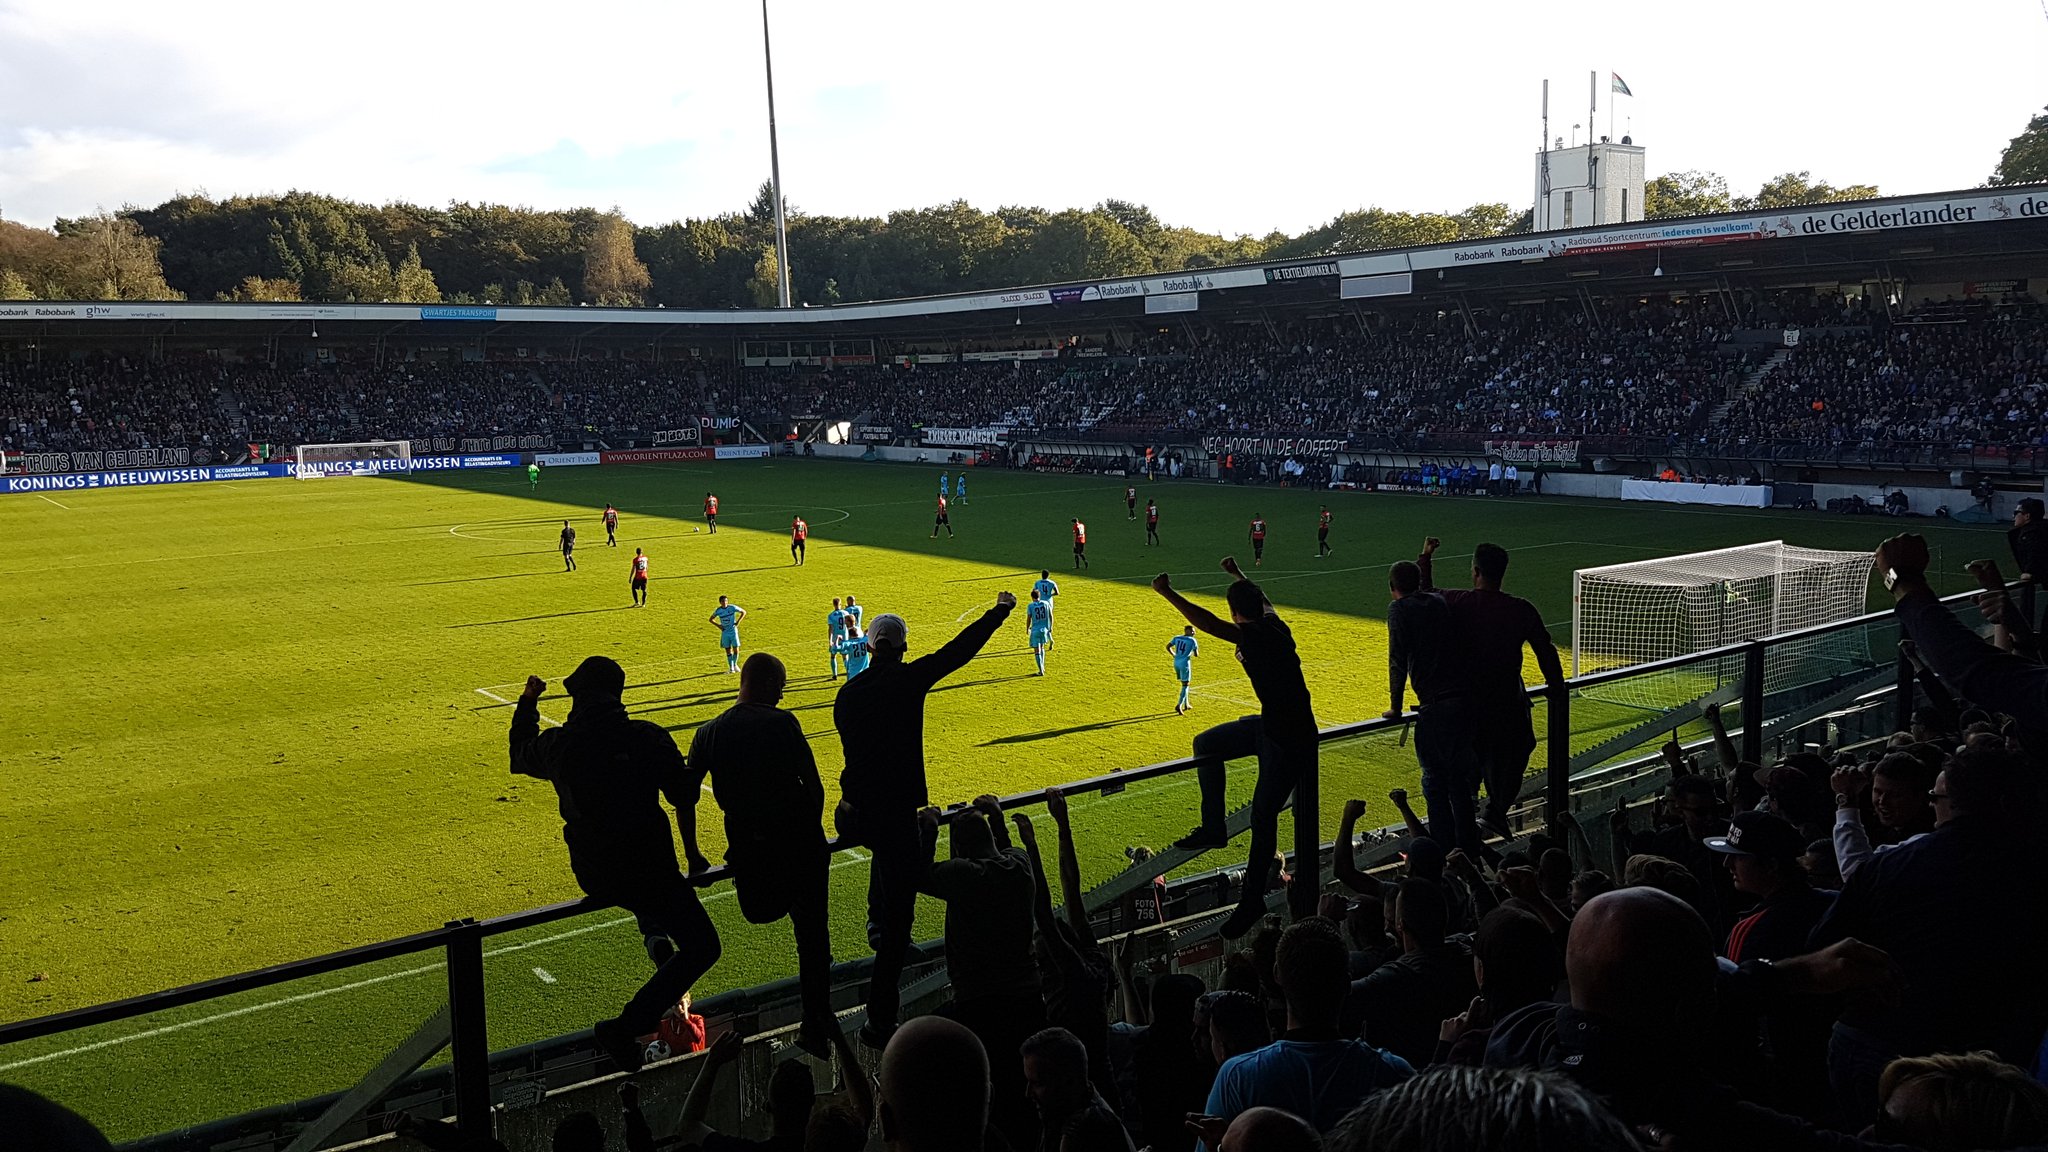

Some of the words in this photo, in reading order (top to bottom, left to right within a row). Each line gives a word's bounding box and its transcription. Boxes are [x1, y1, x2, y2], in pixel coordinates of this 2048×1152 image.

[2020, 196, 2048, 217] de
[1802, 216, 1827, 234] de
[1830, 203, 1976, 230] Gelderlander
[1568, 233, 1602, 247] Radboud
[1604, 231, 1661, 245] Sportcentrum:
[1662, 227, 1701, 238] iedereen
[1703, 226, 1712, 234] is
[1713, 222, 1753, 233] welkom!
[1454, 250, 1495, 262] Rabobank
[1501, 244, 1544, 257] Rabobank
[1273, 271, 1282, 280] DE
[1282, 263, 1339, 280] TEXTIELDRUKKER.NL
[1101, 284, 1138, 297] Rabobank
[1163, 278, 1203, 292] Rabobank
[35, 308, 76, 317] Rabobank
[86, 305, 111, 319] ghw
[425, 309, 457, 317] SWARTJES
[458, 309, 496, 317] TRANSPORT
[701, 416, 740, 429] DUMIĆ
[668, 428, 698, 442] BOYS
[1202, 437, 1223, 454] NEC
[1262, 438, 1276, 455] IN
[1277, 438, 1292, 456] DE
[25, 453, 70, 473] TROTS
[71, 451, 104, 470] VAN
[105, 448, 190, 468] GELDERLAND
[548, 456, 575, 464] ORIENT
[577, 455, 599, 463] PLAZA
[608, 451, 707, 461] WWW.ORIENTPLAZA.COM
[287, 461, 353, 475] KONINGS
[368, 457, 460, 470] MEEUWISSEN
[9, 475, 86, 491] KONINGS
[104, 469, 210, 484] MEEUWISSEN
[1042, 584, 1048, 595] 4
[1034, 607, 1046, 619] 33
[838, 617, 843, 630] 9
[853, 642, 867, 657] 29
[1176, 641, 1186, 653] 14
[1135, 900, 1155, 909] FOTO
[1136, 909, 1155, 920] 756
